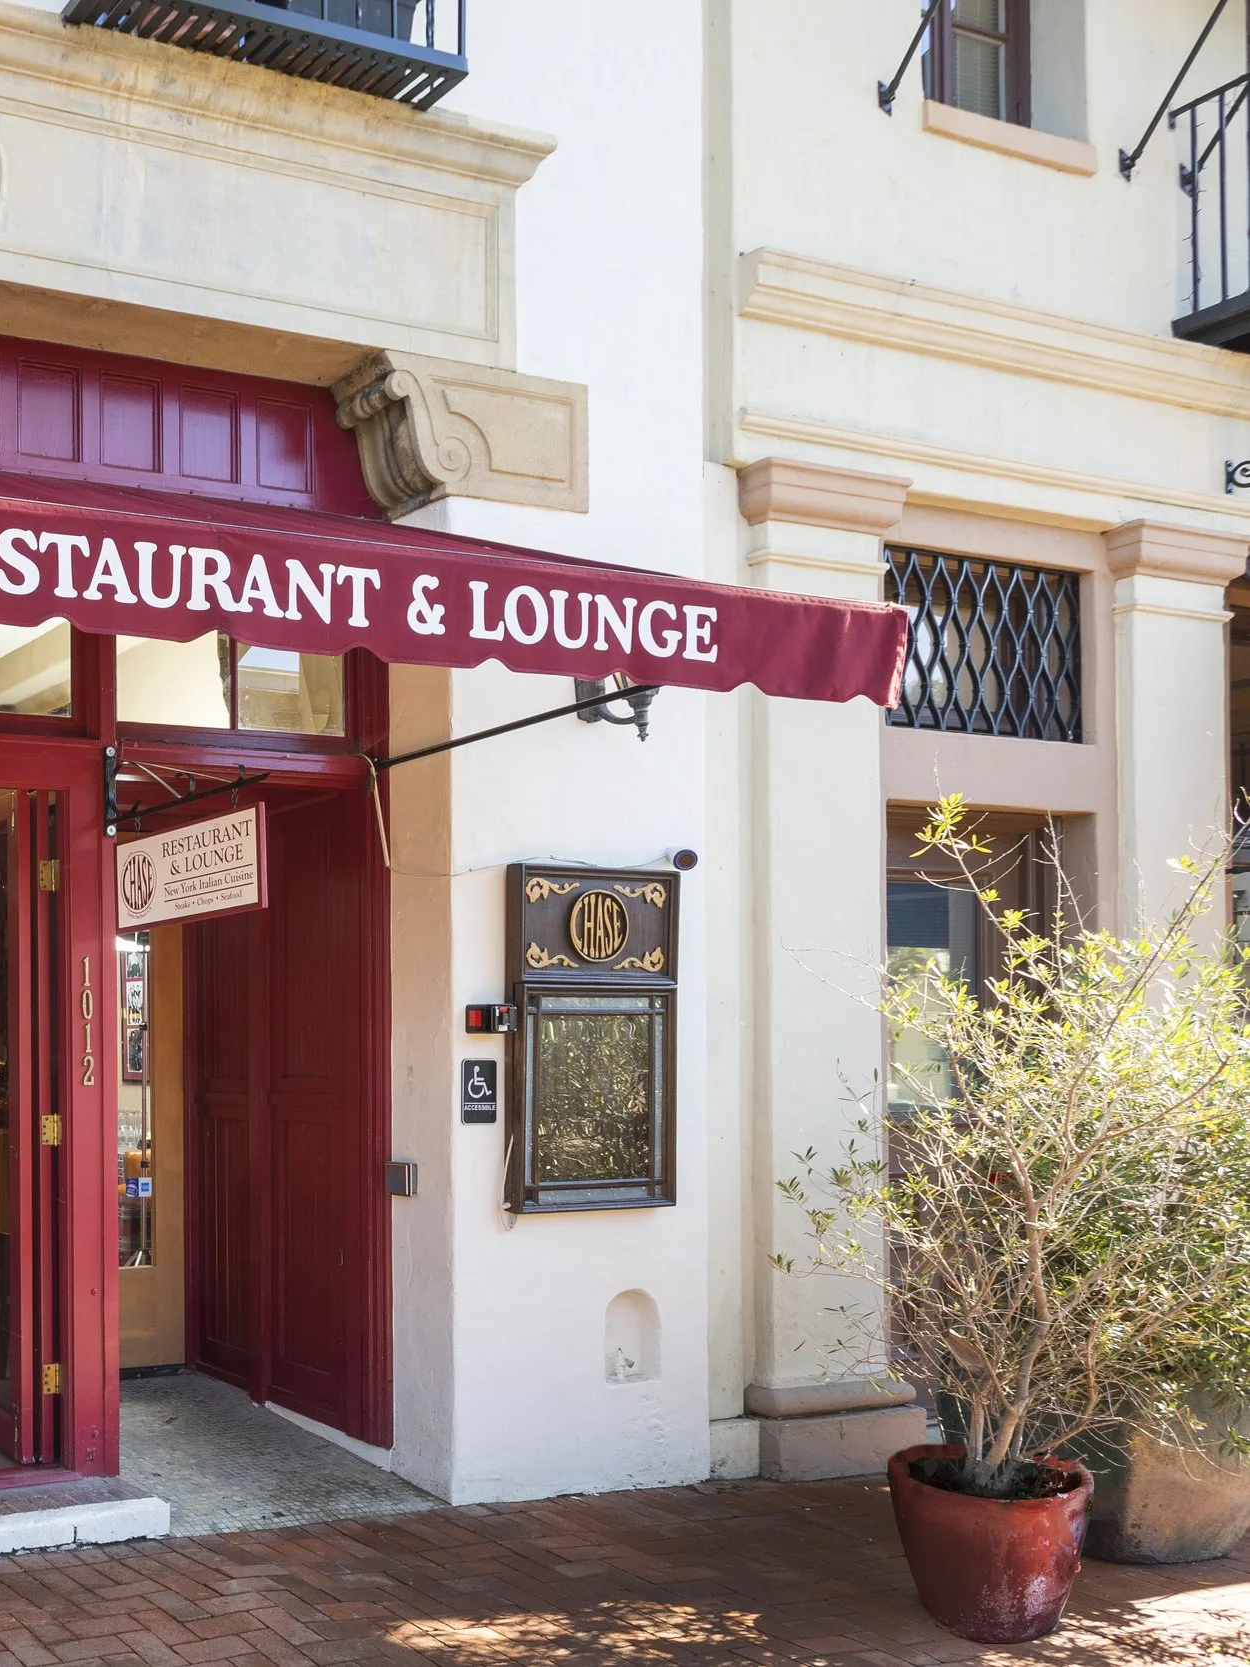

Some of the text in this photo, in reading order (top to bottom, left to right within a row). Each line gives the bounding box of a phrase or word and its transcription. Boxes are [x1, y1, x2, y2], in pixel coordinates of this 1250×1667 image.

[406, 574, 446, 636] &
[468, 580, 719, 663] LOUNGE
[161, 819, 253, 858] RESTAURANT
[170, 843, 244, 876] & LOUNGE
[122, 855, 154, 910] CHASE
[164, 870, 254, 898] New York Italian Cuisine
[174, 889, 243, 910] Steaks Chops Seafood
[570, 894, 623, 958] CHASE
[81, 956, 95, 1085] 1012
